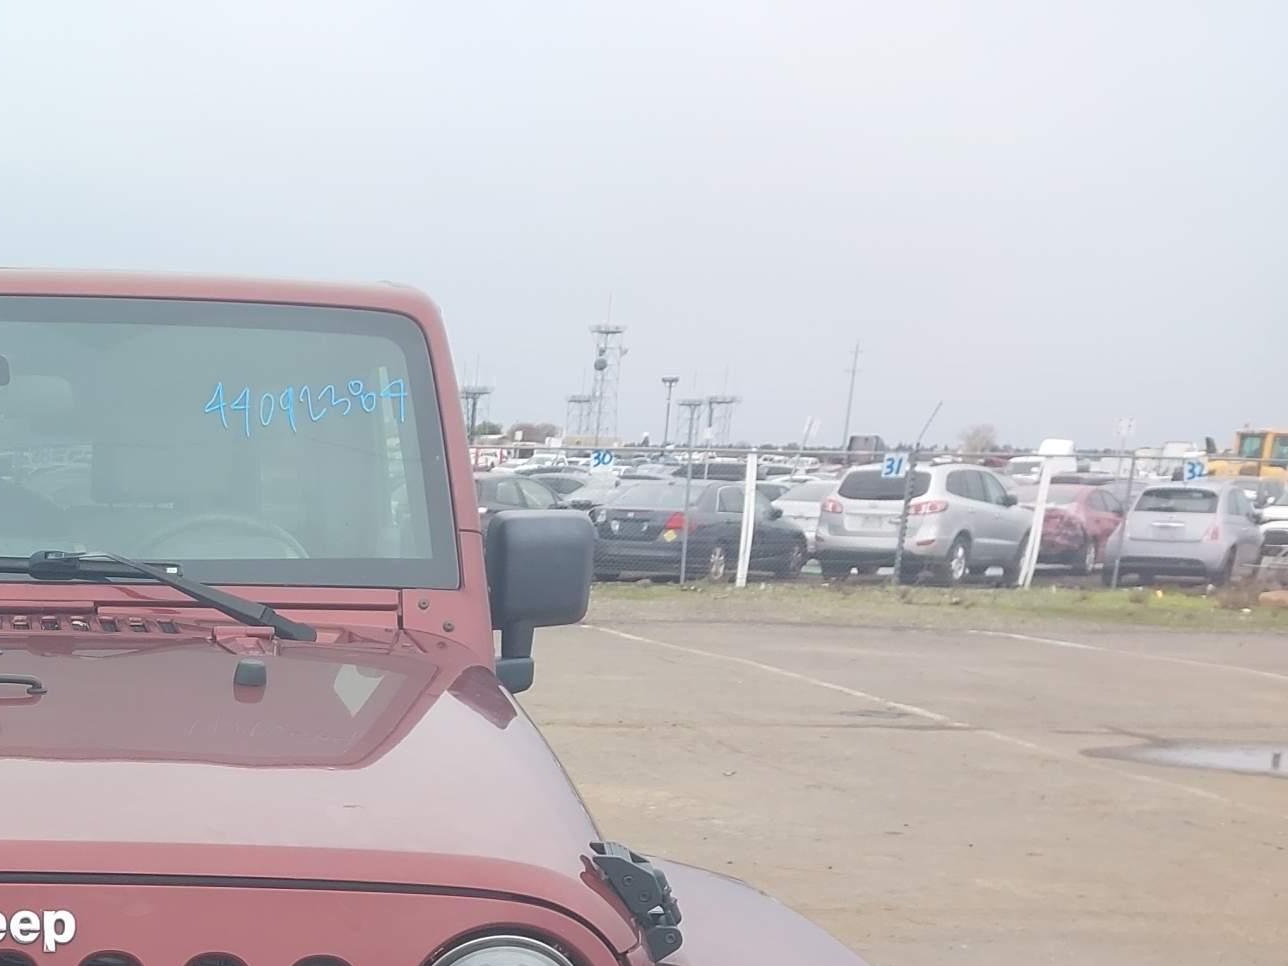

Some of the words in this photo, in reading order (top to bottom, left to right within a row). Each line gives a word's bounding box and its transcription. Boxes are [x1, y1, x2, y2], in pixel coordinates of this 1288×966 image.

[205, 379, 409, 437] 44092384
[592, 449, 613, 467] 30
[884, 458, 903, 475] 31
[1187, 462, 1207, 479] 32
